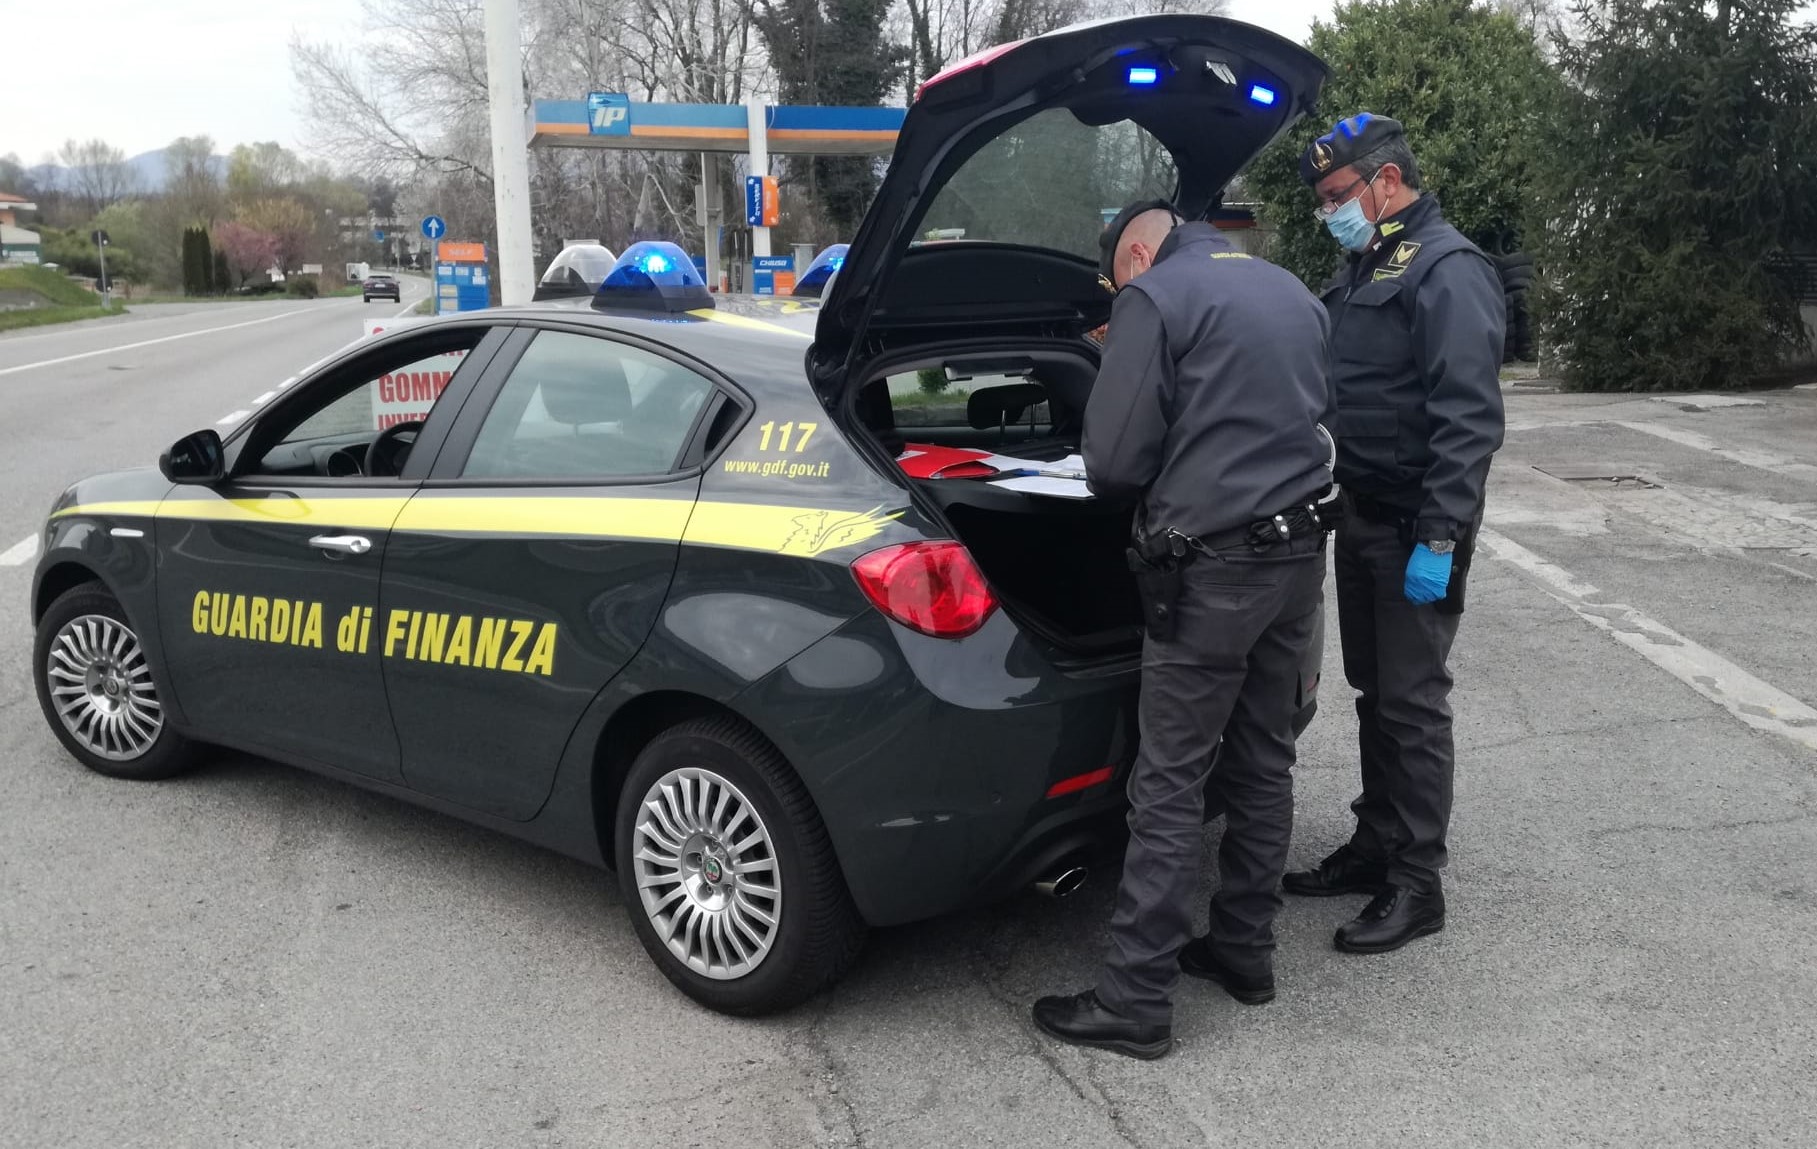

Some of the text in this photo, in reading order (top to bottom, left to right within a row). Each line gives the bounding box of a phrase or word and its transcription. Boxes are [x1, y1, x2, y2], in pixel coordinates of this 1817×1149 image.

[593, 107, 626, 127] IP
[759, 420, 817, 452] 117
[724, 459, 830, 478] www.gdf.gov.it
[192, 590, 558, 676] GUARDIA di FINANZA
